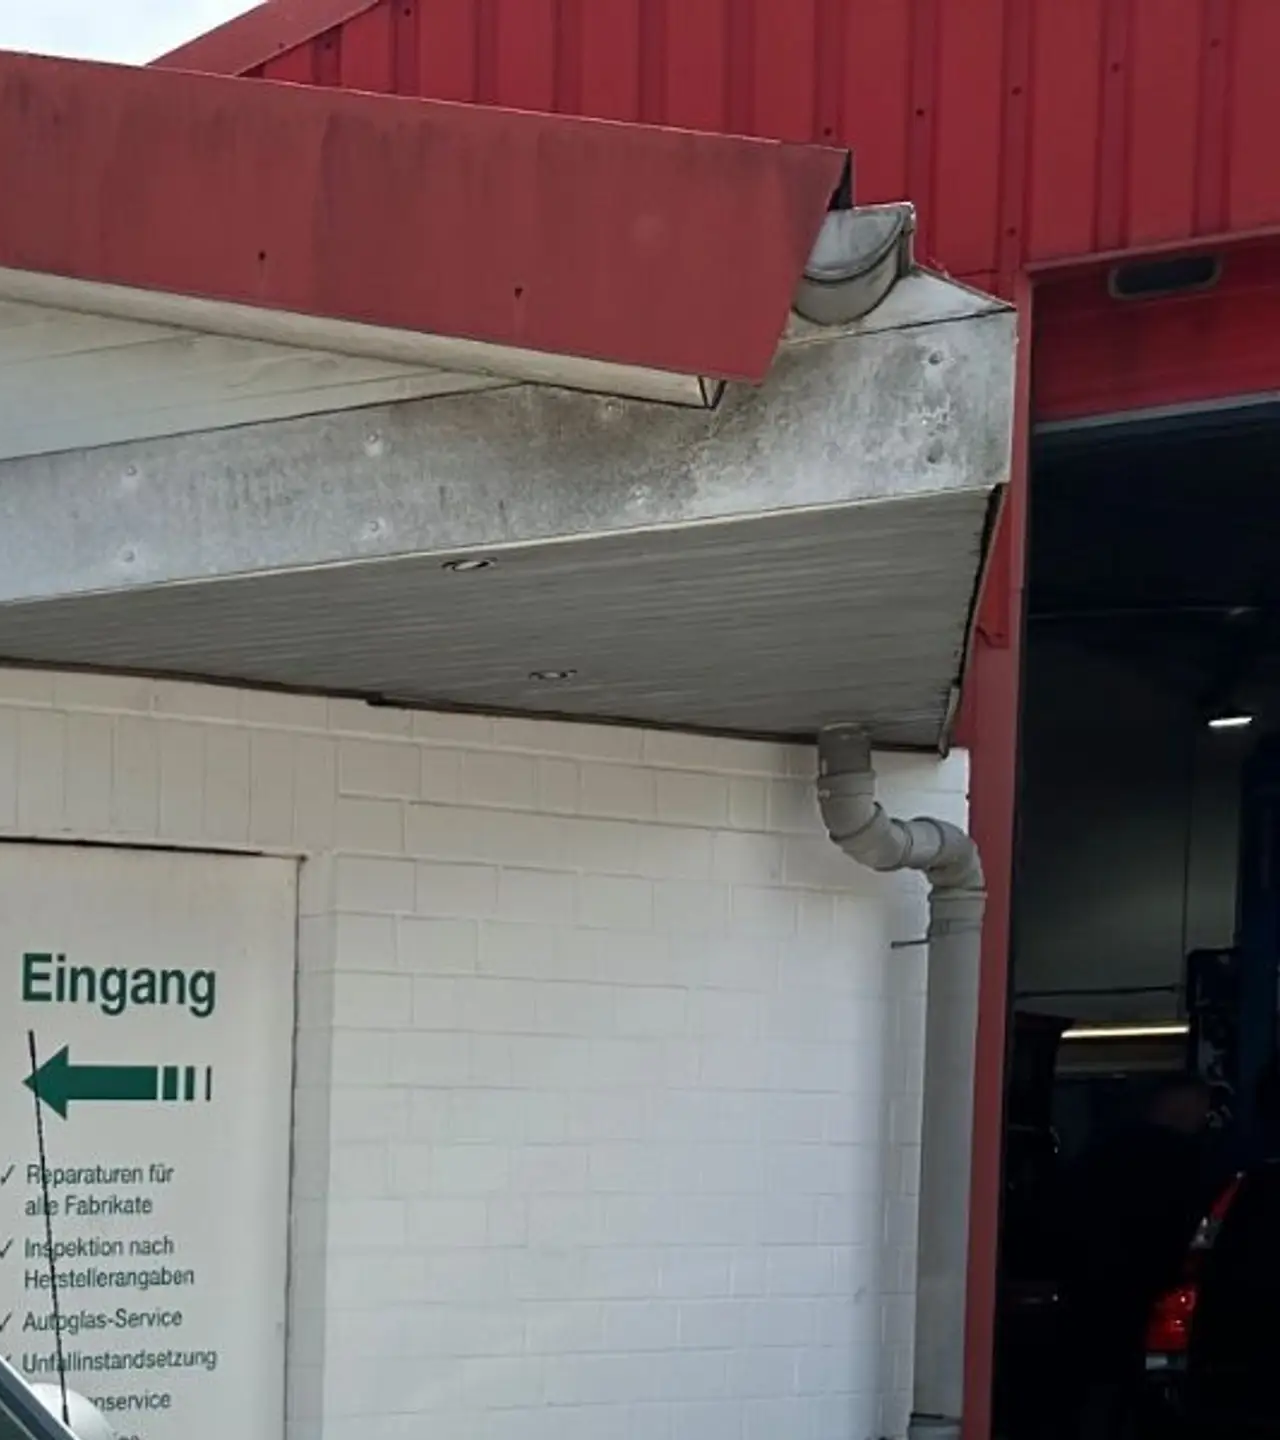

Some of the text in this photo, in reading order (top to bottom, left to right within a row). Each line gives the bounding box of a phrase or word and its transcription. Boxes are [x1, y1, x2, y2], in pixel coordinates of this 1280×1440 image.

[21, 952, 216, 1017] Eingang
[26, 1163, 175, 1188] Reparaturen für
[24, 1194, 153, 1216] alle Fabrikate
[24, 1235, 175, 1261] Inspektion nach
[22, 1307, 183, 1335] Autoglas-Service
[22, 1349, 218, 1374] Unfallinstandsetzung
[88, 1388, 172, 1412] nservice
